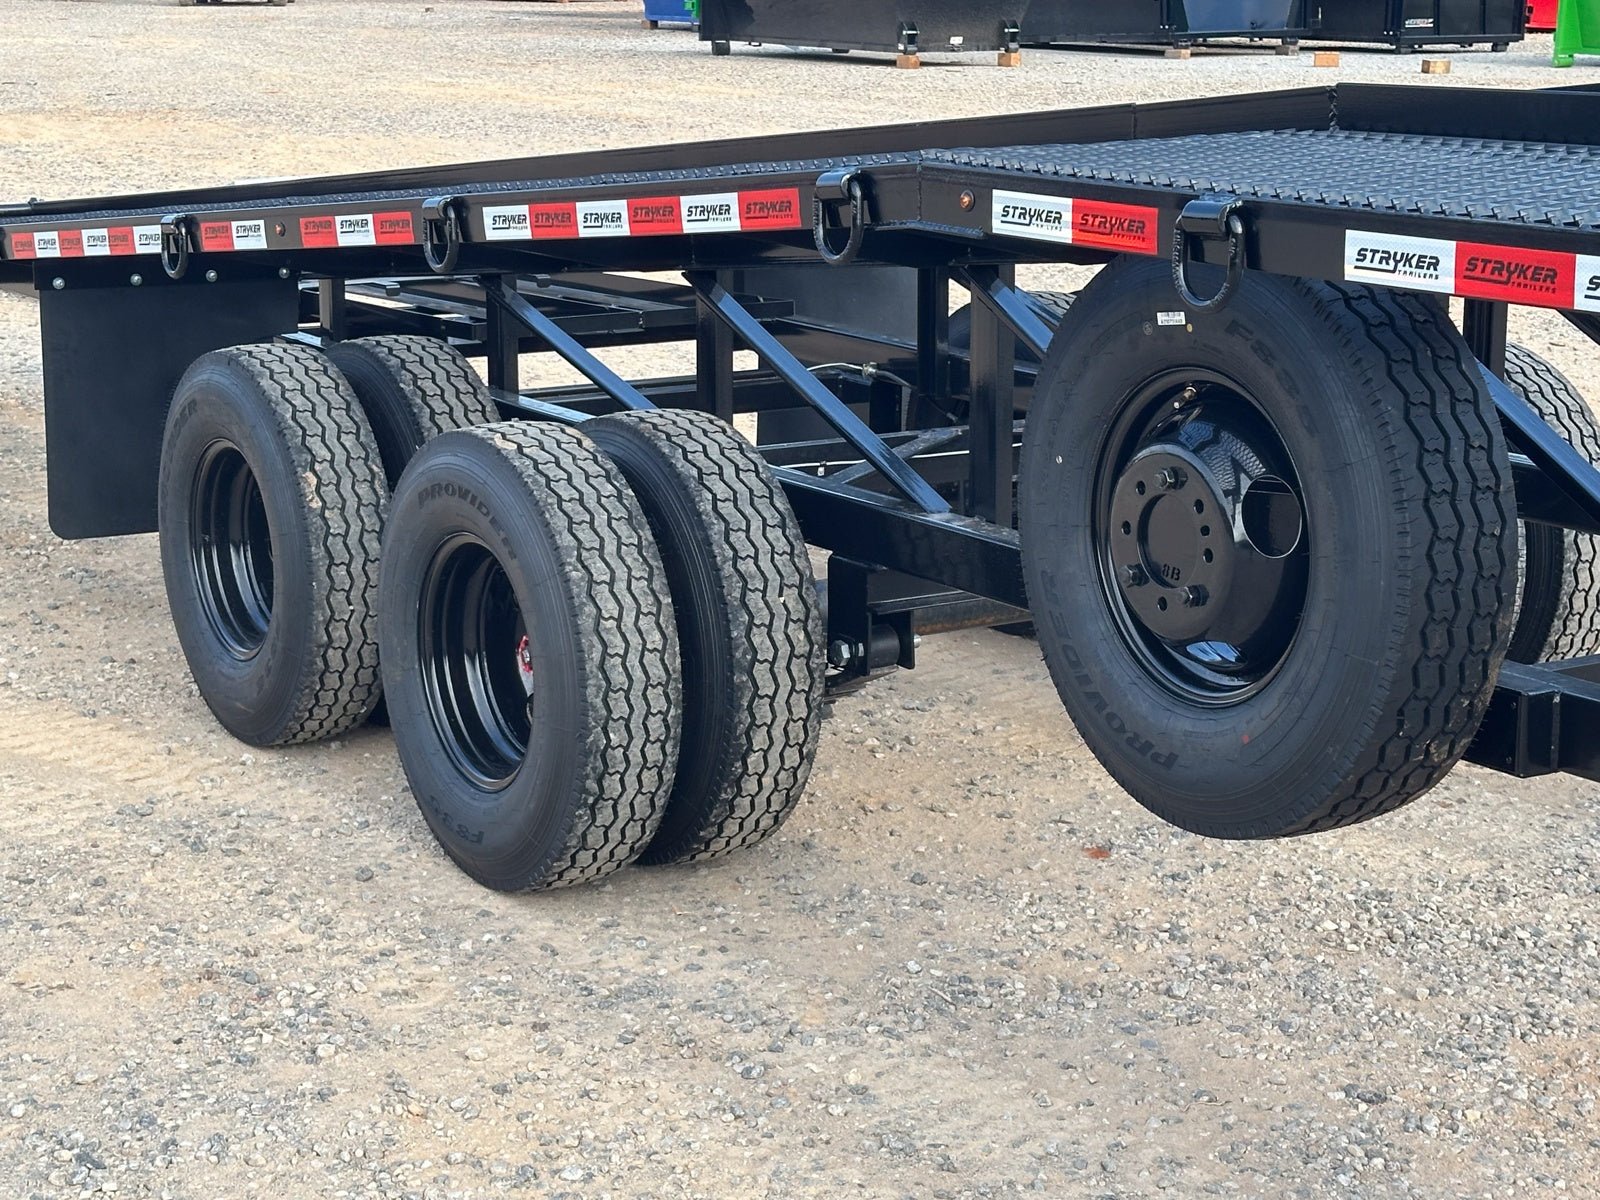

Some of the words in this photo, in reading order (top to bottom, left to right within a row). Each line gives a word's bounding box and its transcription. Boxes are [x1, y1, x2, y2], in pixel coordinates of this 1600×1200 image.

[632, 205, 675, 223] STRYKER
[687, 203, 731, 222] STRYKER
[745, 199, 792, 219] STRYKER
[1000, 205, 1063, 227] STRYKER
[304, 220, 332, 234] STRYKER
[340, 218, 369, 234] STRYKER
[380, 219, 410, 234] STRYKER
[492, 214, 528, 231] STRYKER
[534, 212, 572, 228] STRYKER
[583, 212, 622, 229] STRYKER
[1078, 213, 1146, 236] STRYKER
[205, 226, 229, 239] STRYKER
[236, 225, 261, 238] STRYKER
[1353, 246, 1441, 274] STRYKER
[1397, 269, 1441, 280] TRAILERS
[1463, 256, 1558, 286] STRYKER
[1510, 281, 1557, 294] TRAILERS
[418, 482, 517, 560] PROVIDER
[1040, 570, 1179, 772] PROVIDER
